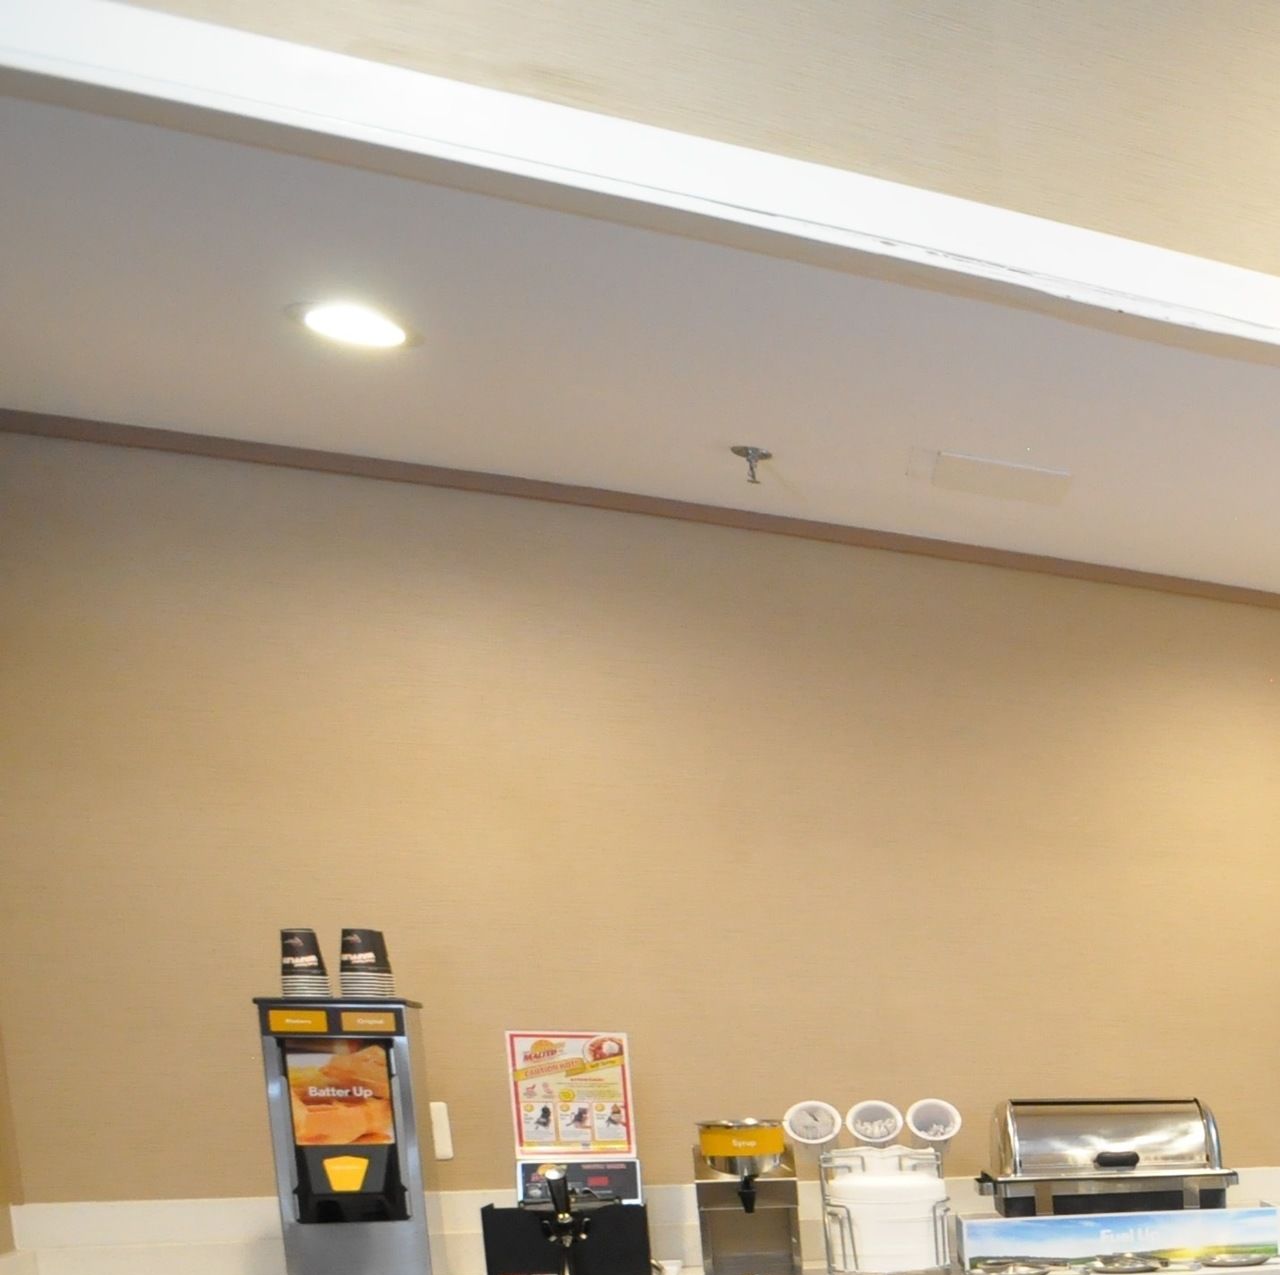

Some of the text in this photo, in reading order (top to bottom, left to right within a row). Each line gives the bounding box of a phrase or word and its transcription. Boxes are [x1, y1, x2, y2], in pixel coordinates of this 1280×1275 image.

[308, 1086, 373, 1098] Batter Up
[1100, 1228, 1134, 1241] Fuel
